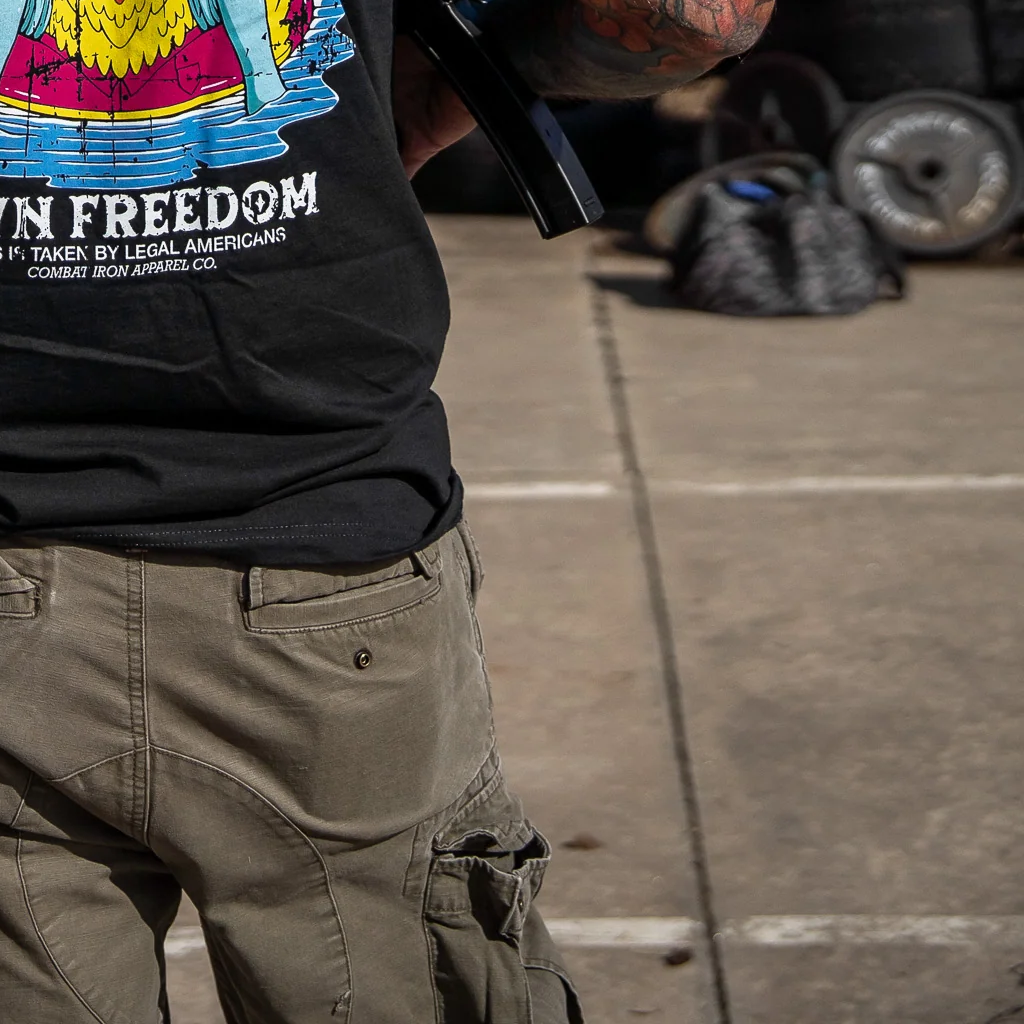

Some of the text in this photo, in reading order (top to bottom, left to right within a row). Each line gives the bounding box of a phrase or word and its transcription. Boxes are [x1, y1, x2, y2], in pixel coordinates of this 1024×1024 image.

[70, 171, 320, 239] FREEDOM
[30, 244, 89, 262] TAKEN
[94, 244, 120, 261] BY
[125, 239, 181, 261] LEGAL
[184, 226, 287, 255] AMERICANS
[27, 256, 218, 279] COMBAT IRON APPAREL CO.
